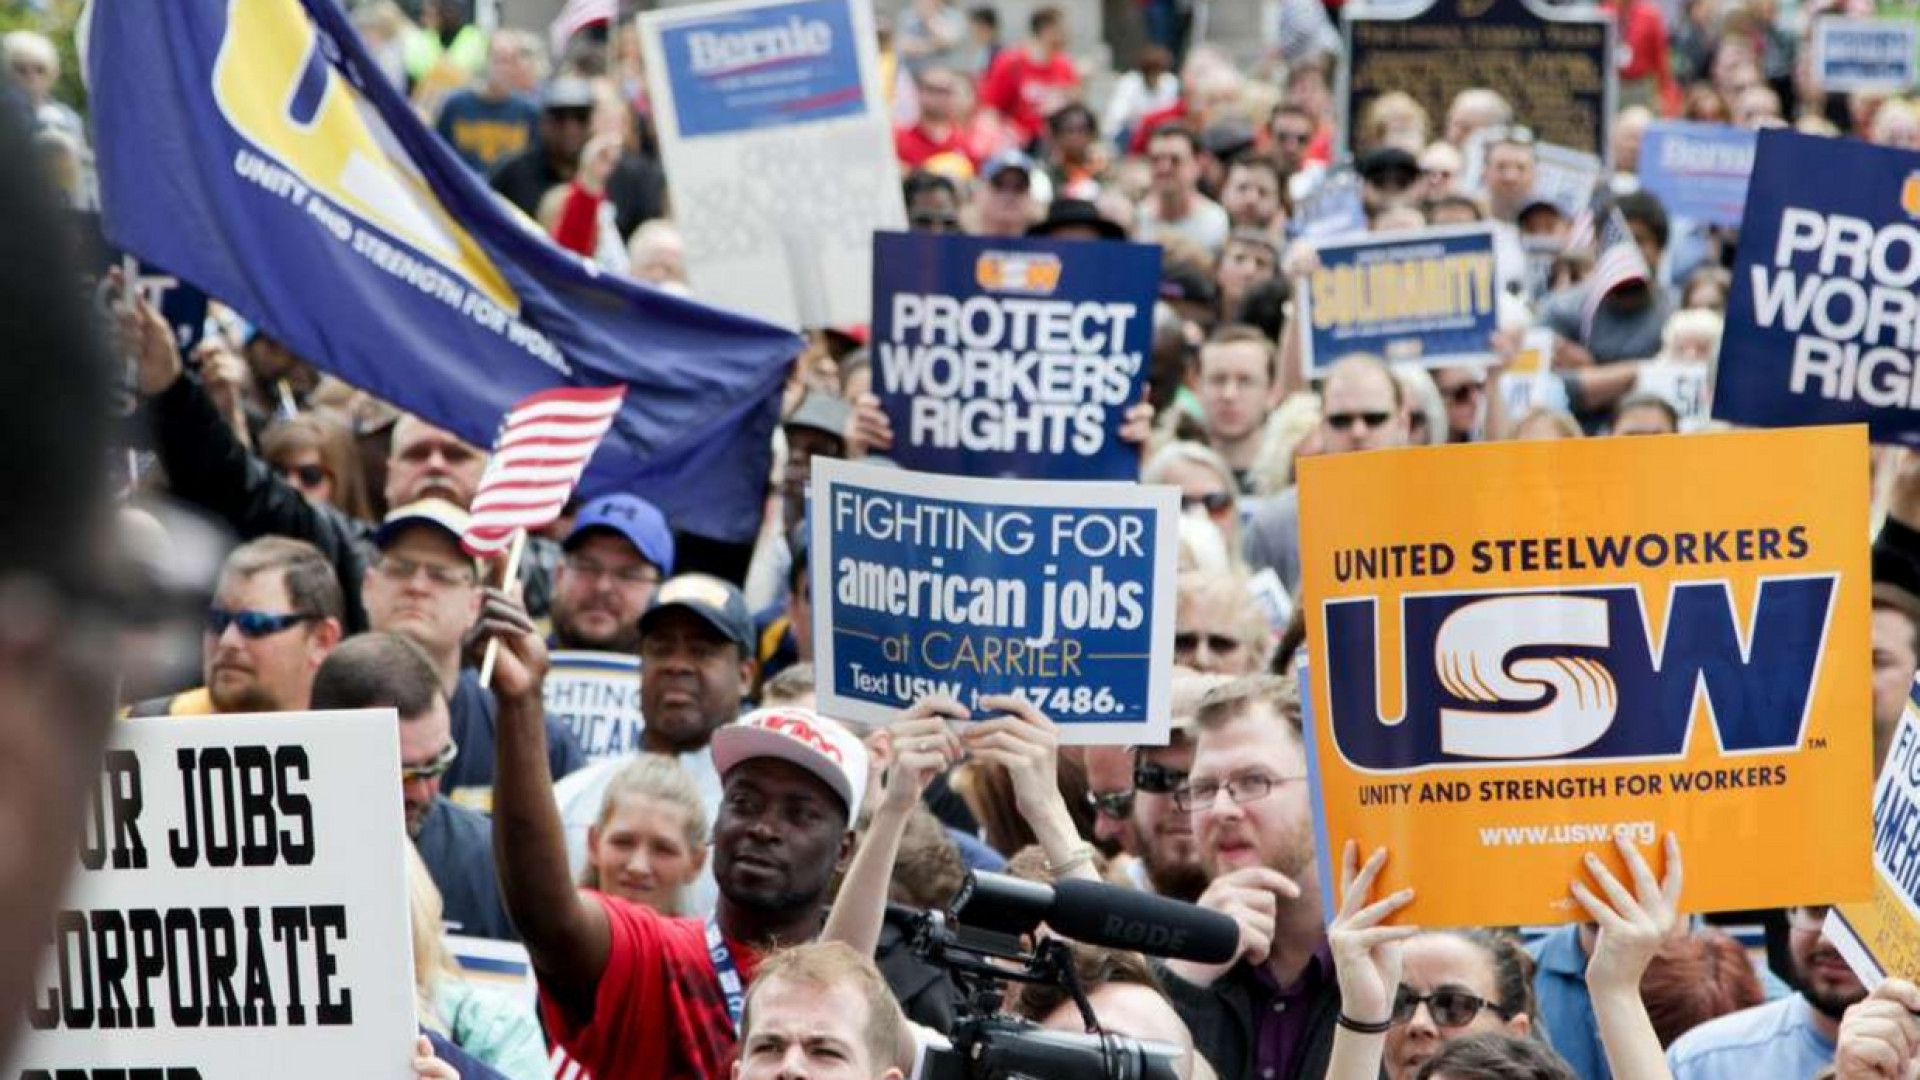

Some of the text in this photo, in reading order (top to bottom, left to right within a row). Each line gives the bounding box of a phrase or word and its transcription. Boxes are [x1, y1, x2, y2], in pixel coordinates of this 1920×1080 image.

[687, 14, 833, 75] Bernie
[233, 149, 309, 206] UNITY
[351, 227, 464, 308] STRENGTH
[462, 292, 509, 335] FOR
[1774, 206, 1920, 288] PRO
[891, 293, 1139, 354] PROTECT
[1312, 254, 1493, 331] SOLIDARITY
[1751, 263, 1920, 349] WOR
[879, 342, 1144, 406] WORKERS'
[911, 397, 1107, 456] RIGHTS
[835, 491, 1145, 557] FIGHTING FOR
[1333, 525, 1810, 582] UNITED STEELWORKERS
[838, 556, 1144, 648] american jobs
[849, 663, 889, 696] Text
[883, 631, 1081, 678] at CARRIER
[1321, 571, 1841, 776] USW
[169, 745, 315, 868] JOBS
[1359, 765, 1787, 806] UNITY AND STRENGTH FOR WORKERS
[1480, 820, 1656, 846] www.usw.org
